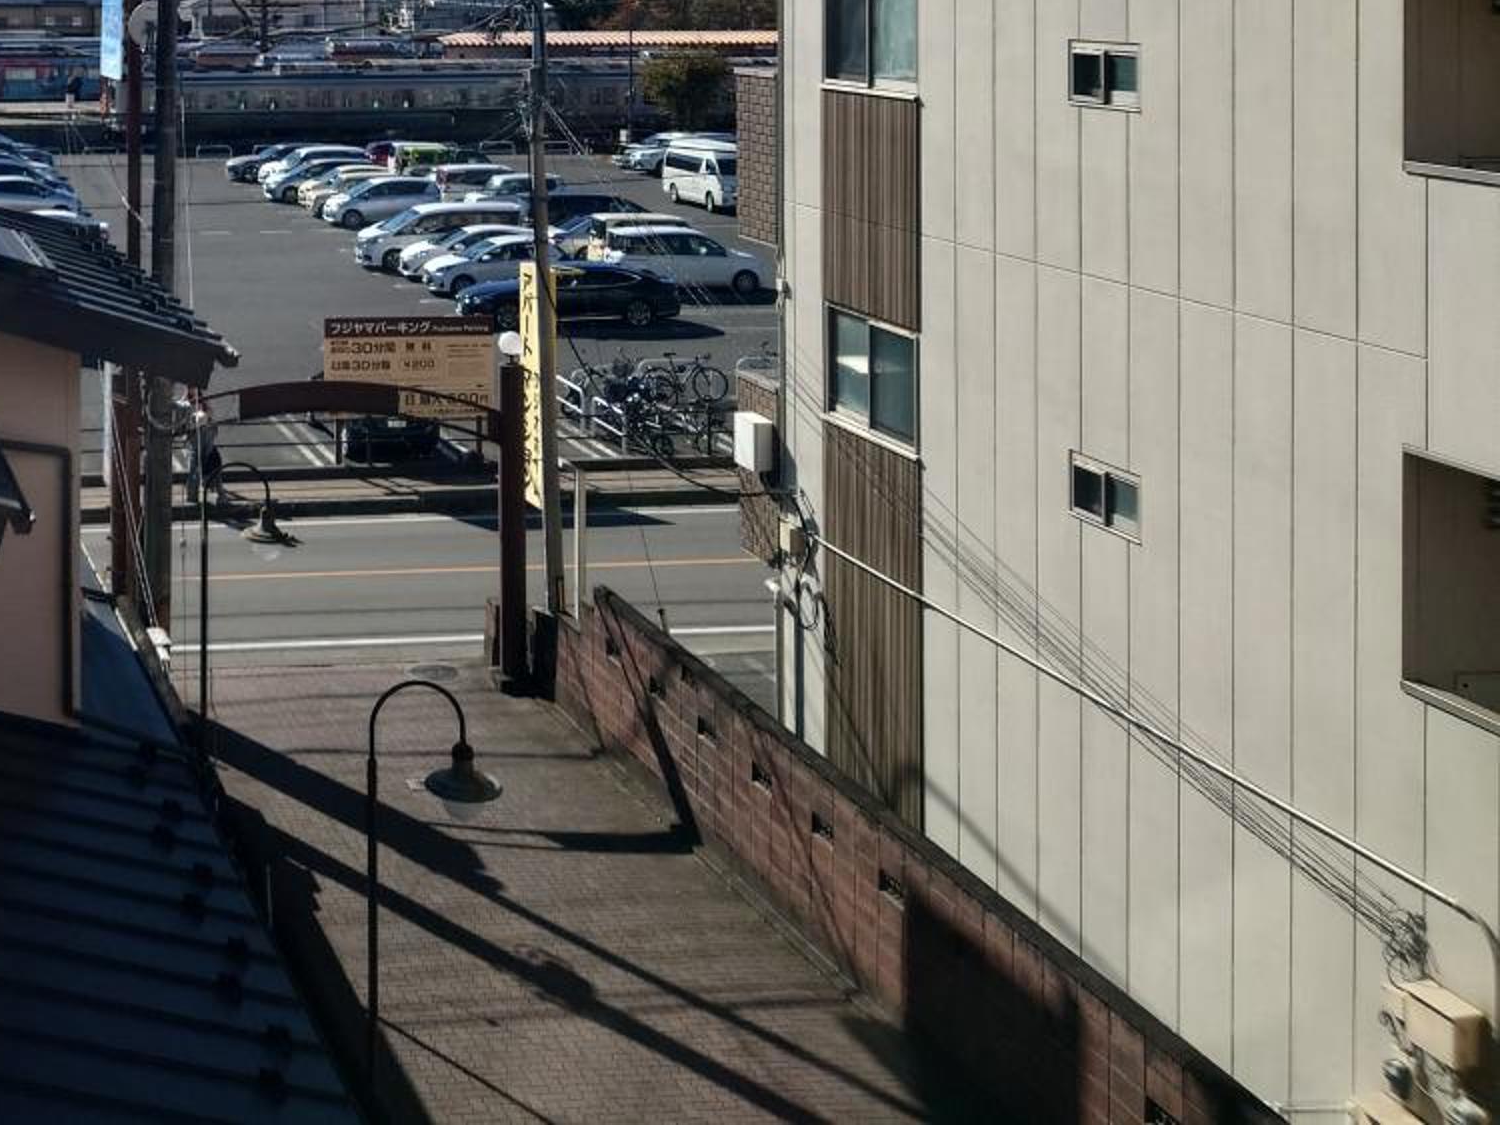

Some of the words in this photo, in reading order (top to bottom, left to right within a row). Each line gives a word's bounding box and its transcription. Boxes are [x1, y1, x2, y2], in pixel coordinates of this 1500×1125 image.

[330, 320, 431, 335] フジヤマパーキング
